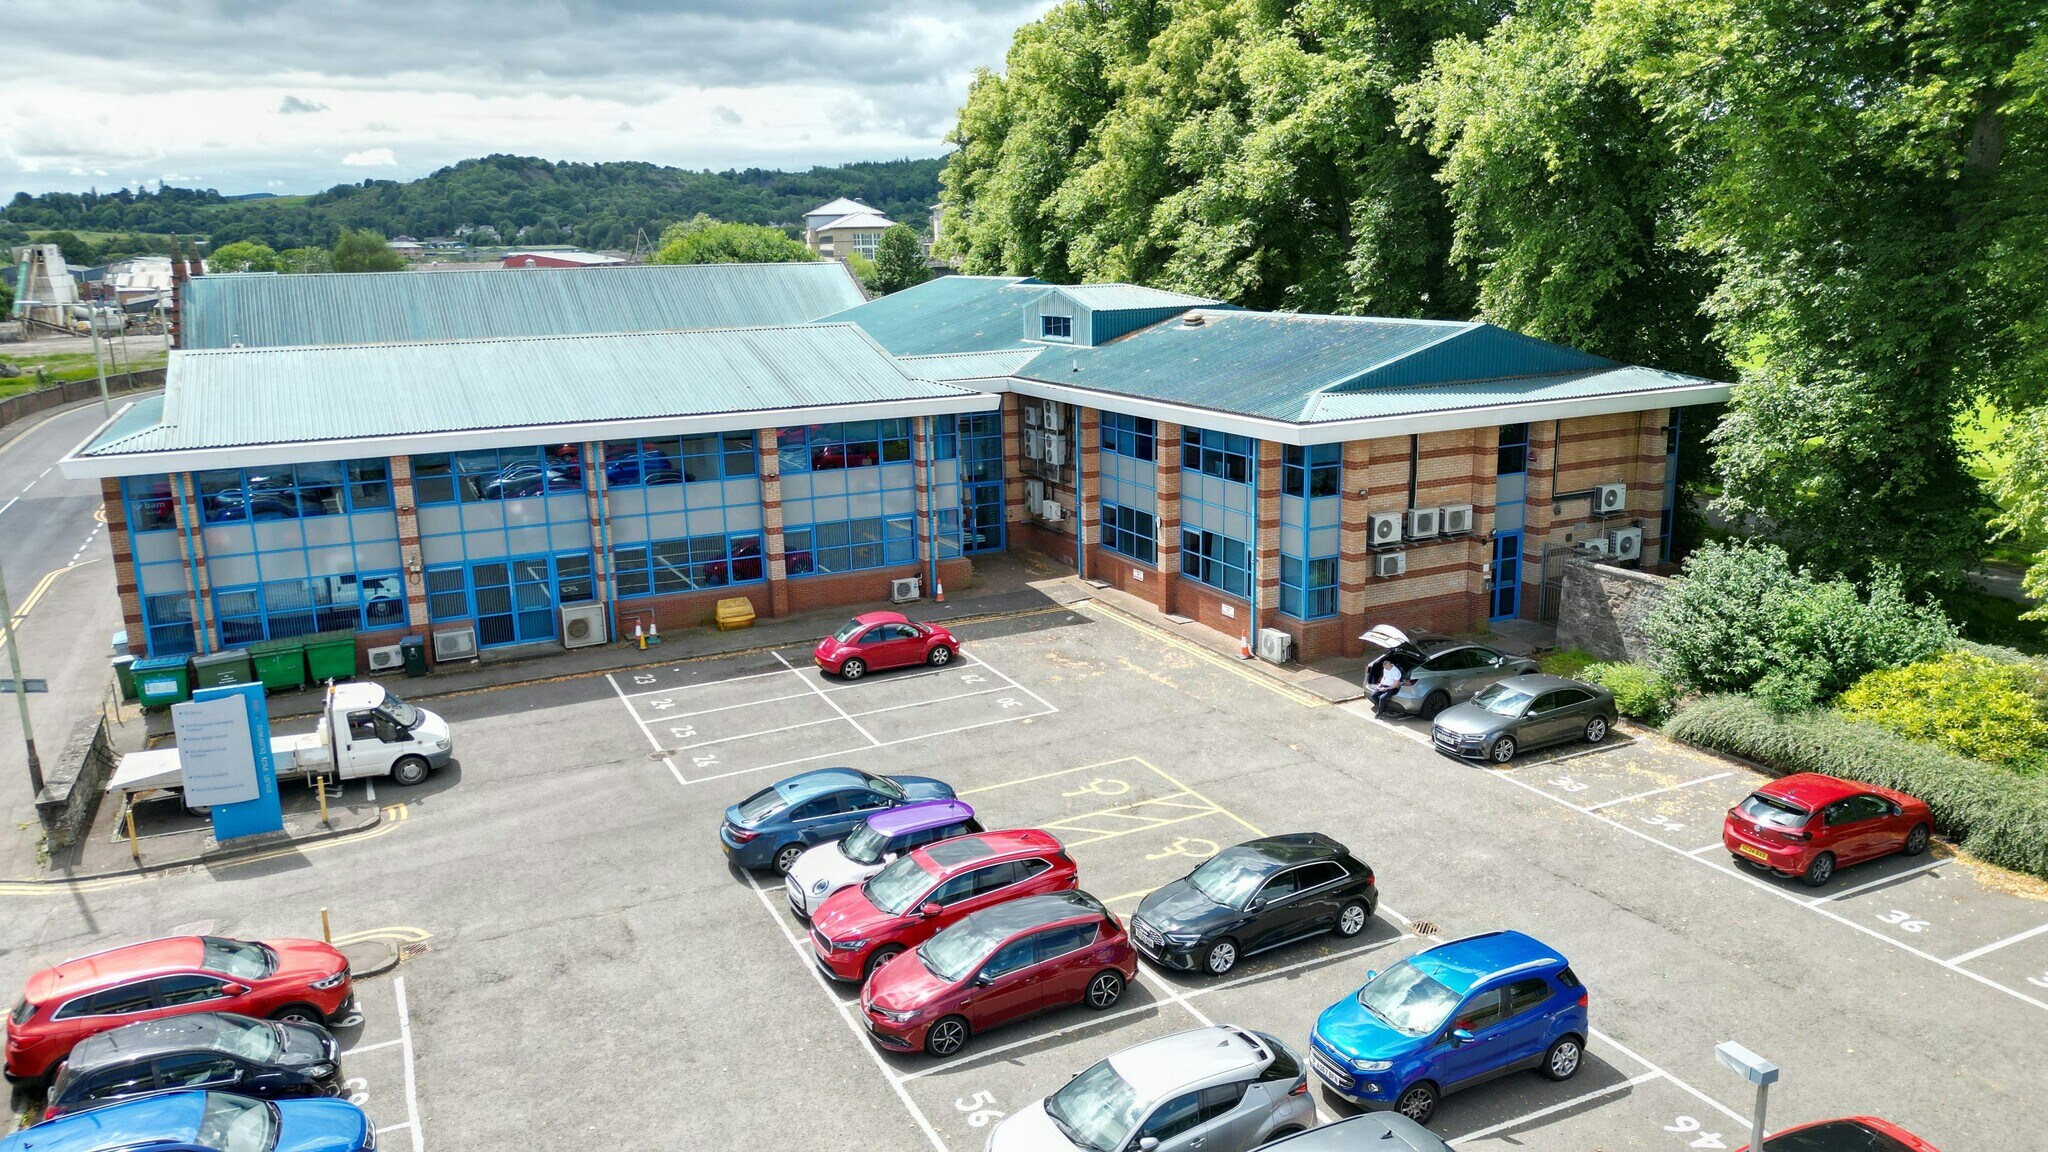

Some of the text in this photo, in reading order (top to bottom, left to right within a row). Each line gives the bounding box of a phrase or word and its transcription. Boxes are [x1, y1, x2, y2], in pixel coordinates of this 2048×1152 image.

[634, 674, 656, 684] 23
[961, 674, 986, 684] 29
[651, 698, 675, 709] 24
[997, 697, 1022, 708] 30
[671, 725, 697, 738] 25
[261, 757, 269, 771] inch
[693, 754, 720, 767] 26
[1640, 814, 1685, 831] 34
[1875, 909, 1930, 932] 36
[955, 1090, 1005, 1127] 56
[1664, 1116, 1727, 1149] 46
